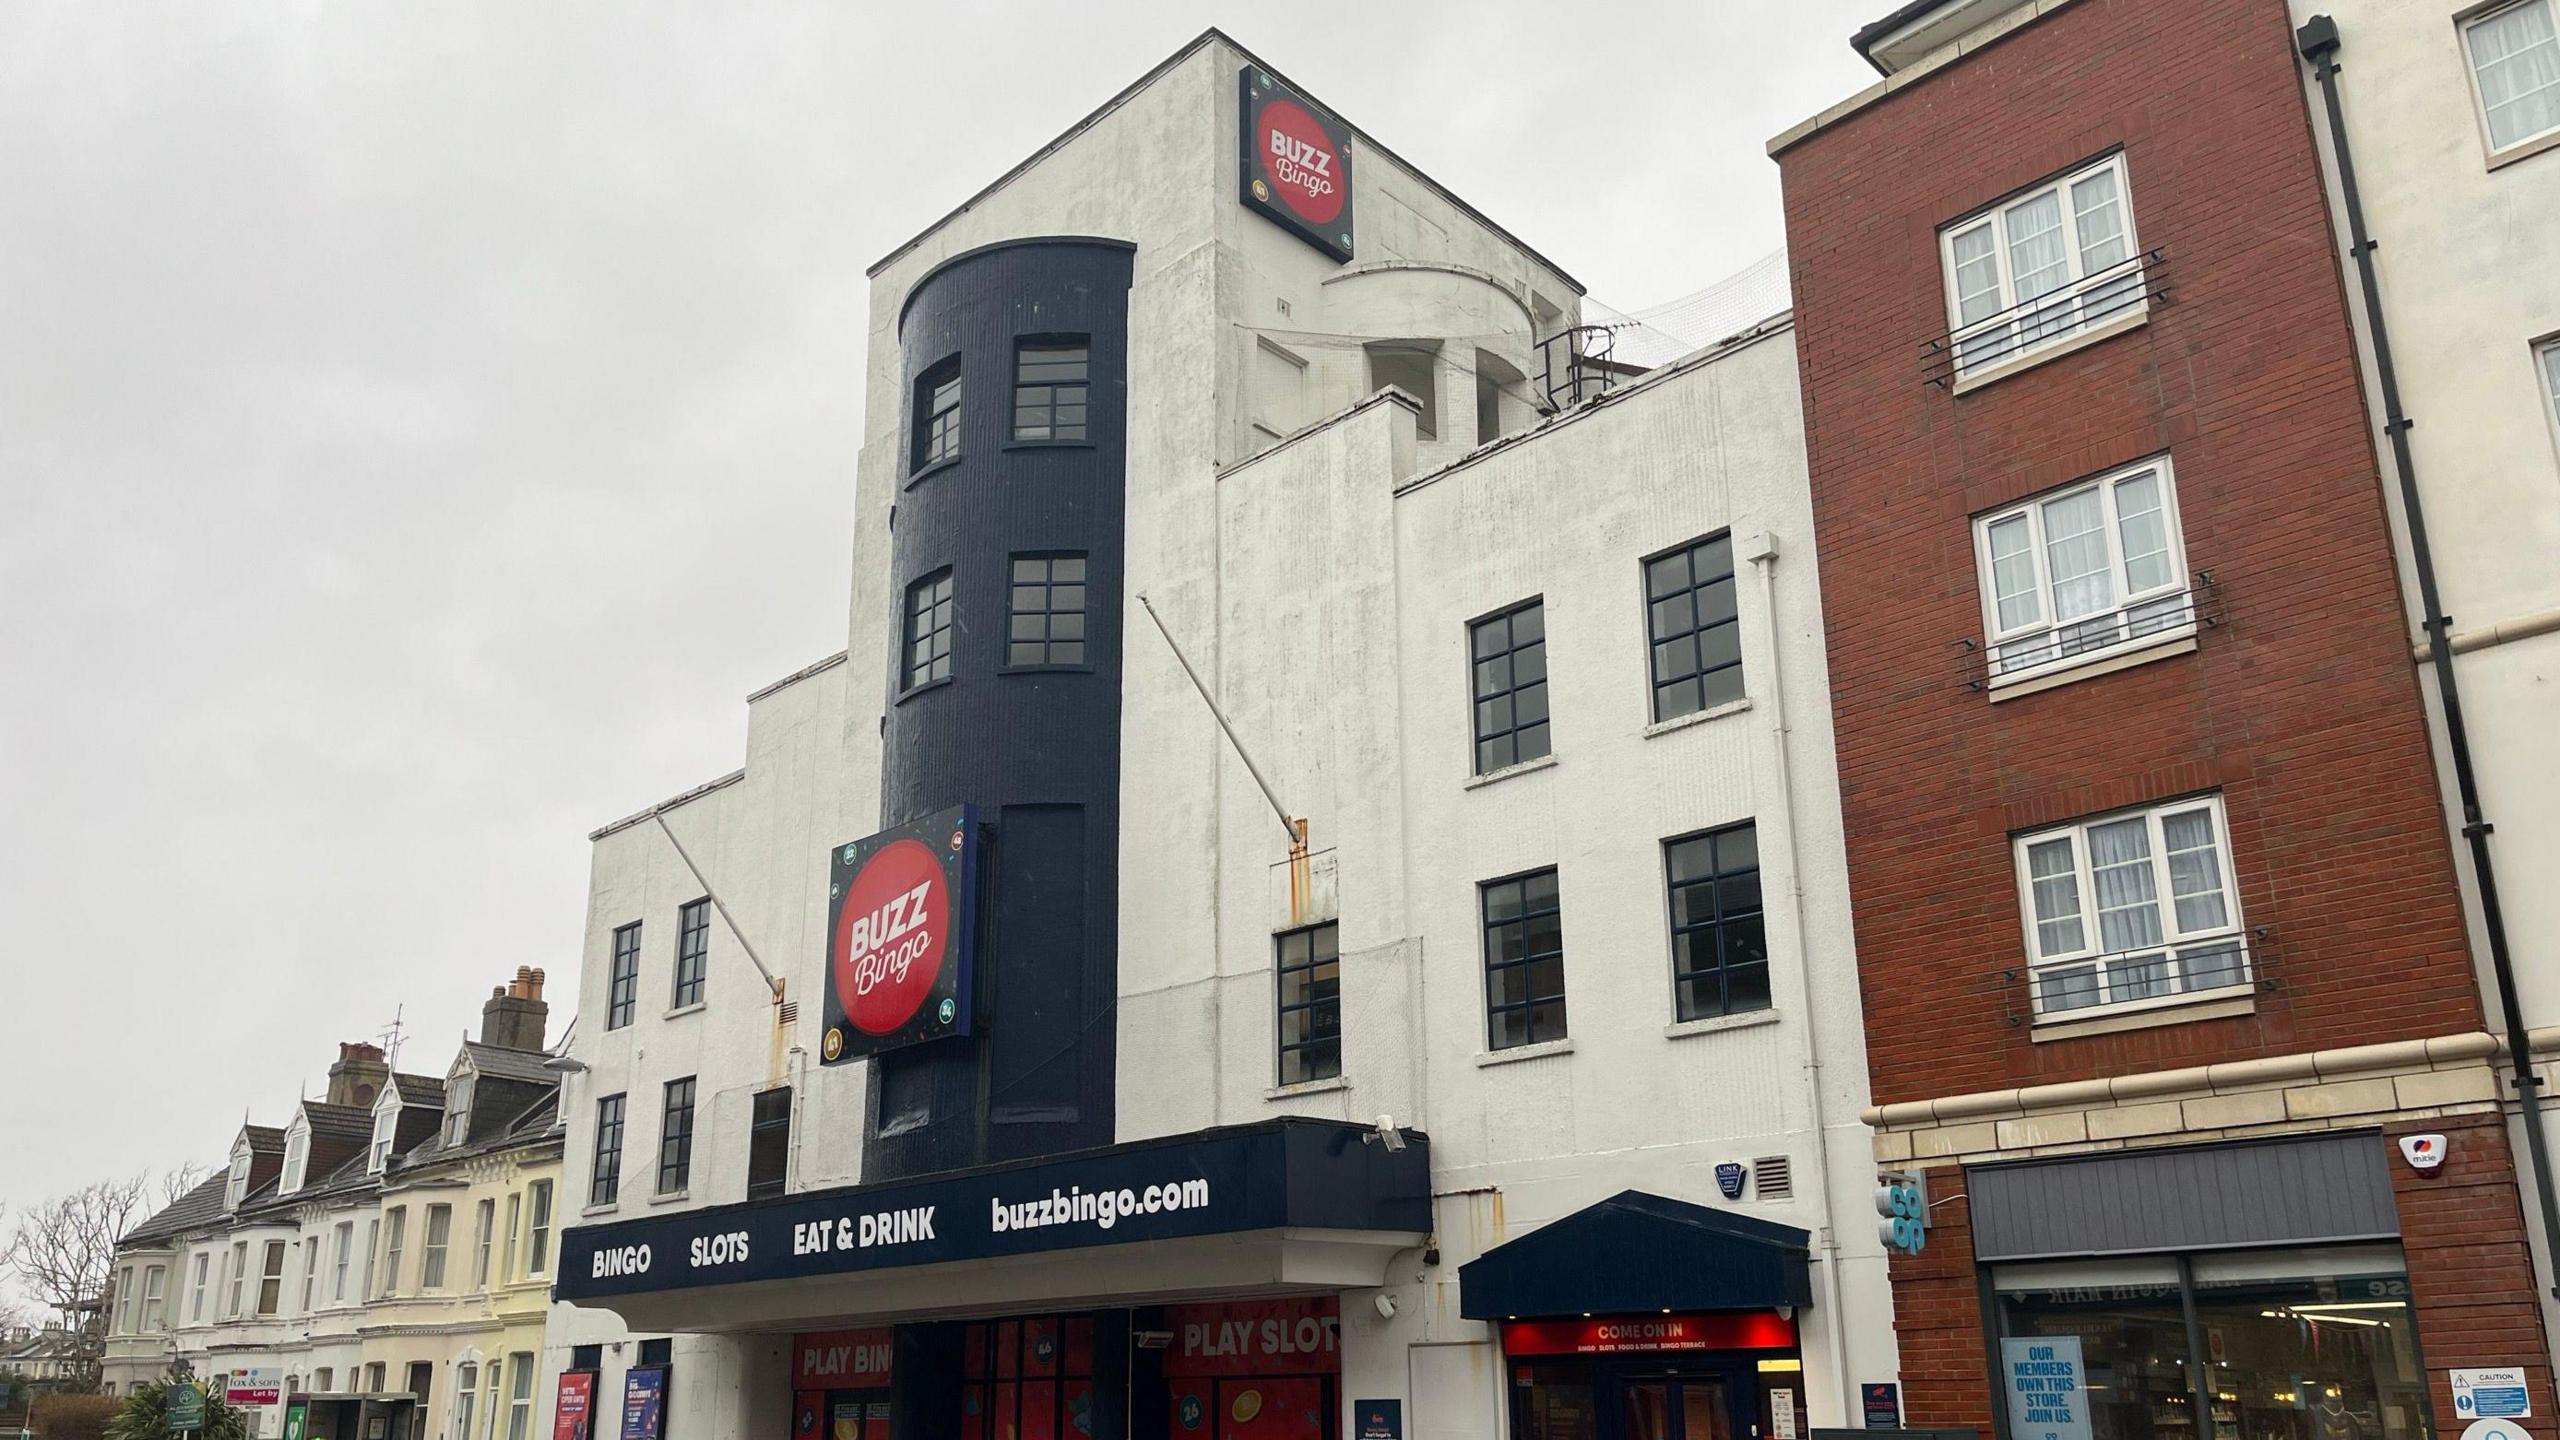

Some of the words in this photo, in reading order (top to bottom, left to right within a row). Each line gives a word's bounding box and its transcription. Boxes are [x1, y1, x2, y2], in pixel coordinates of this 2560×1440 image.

[1271, 129, 1331, 177] BUZZ
[1276, 158, 1334, 198] Bingo
[850, 880, 931, 963] BUZZ
[855, 930, 932, 995] Bingo
[2413, 1154, 2436, 1162] mitie
[1718, 1165, 1738, 1173] LINK
[592, 1244, 651, 1278] BINGO
[690, 1231, 749, 1267] SLOTS
[794, 1220, 832, 1255] EAT
[836, 1217, 854, 1250] &
[859, 1206, 935, 1247] DRINK
[992, 1178, 1209, 1232] buzzbingo.com
[1184, 1320, 1254, 1357] PLAY
[1261, 1316, 1341, 1354] SLOT
[1598, 1325, 1640, 1339] COME
[1644, 1324, 1664, 1336] ON
[1668, 1323, 1682, 1336] IN
[803, 1346, 851, 1376] PLAY
[854, 1344, 893, 1374] BIN
[2029, 1346, 2054, 1360] OUR
[2014, 1362, 2073, 1376] MEMBERS
[230, 1377, 246, 1387] fox
[249, 1377, 257, 1387] &
[2016, 1378, 2044, 1391] OWN
[2045, 1377, 2074, 1391] THIS
[267, 1390, 278, 1398] by
[2026, 1393, 2068, 1407] STORE.
[1184, 1404, 1198, 1421] 26
[2025, 1409, 2052, 1423] JOIN
[2055, 1409, 2074, 1423] US.
